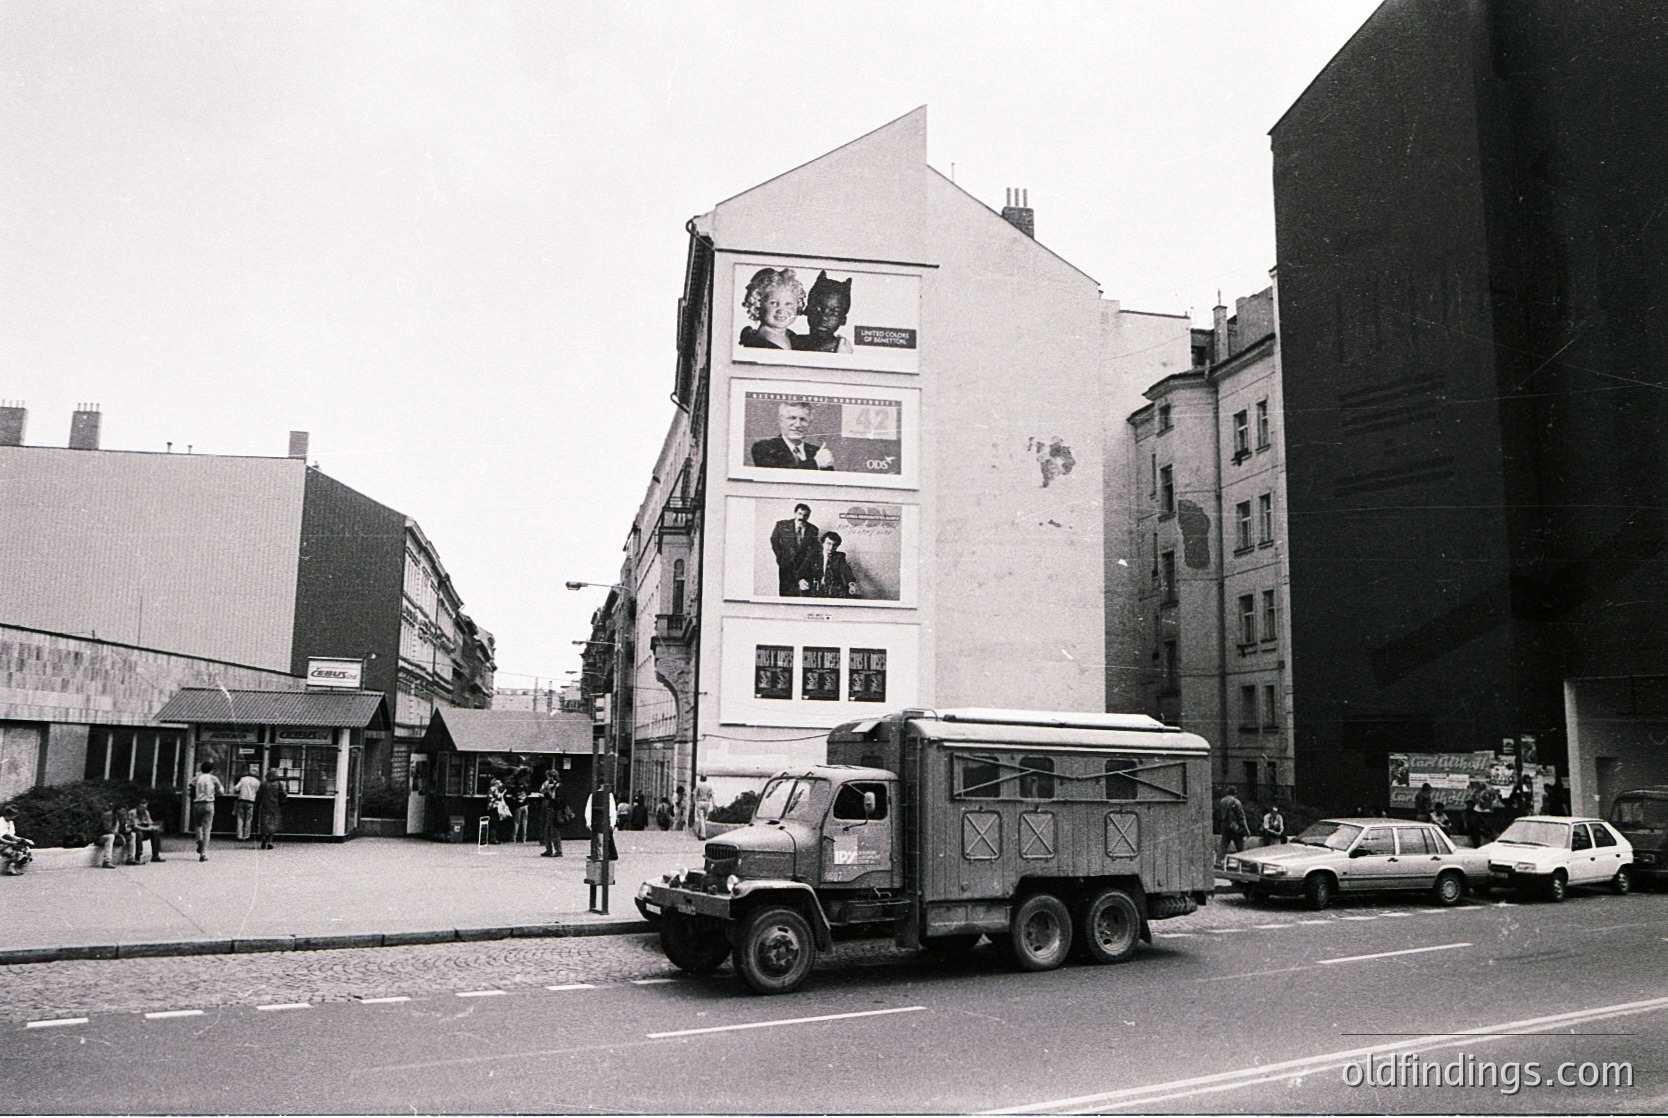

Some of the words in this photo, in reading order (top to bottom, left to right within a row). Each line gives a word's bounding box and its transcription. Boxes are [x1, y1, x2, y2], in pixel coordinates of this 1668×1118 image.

[885, 331, 909, 339] COLORS
[856, 408, 889, 430] 42
[866, 459, 888, 469] ODS
